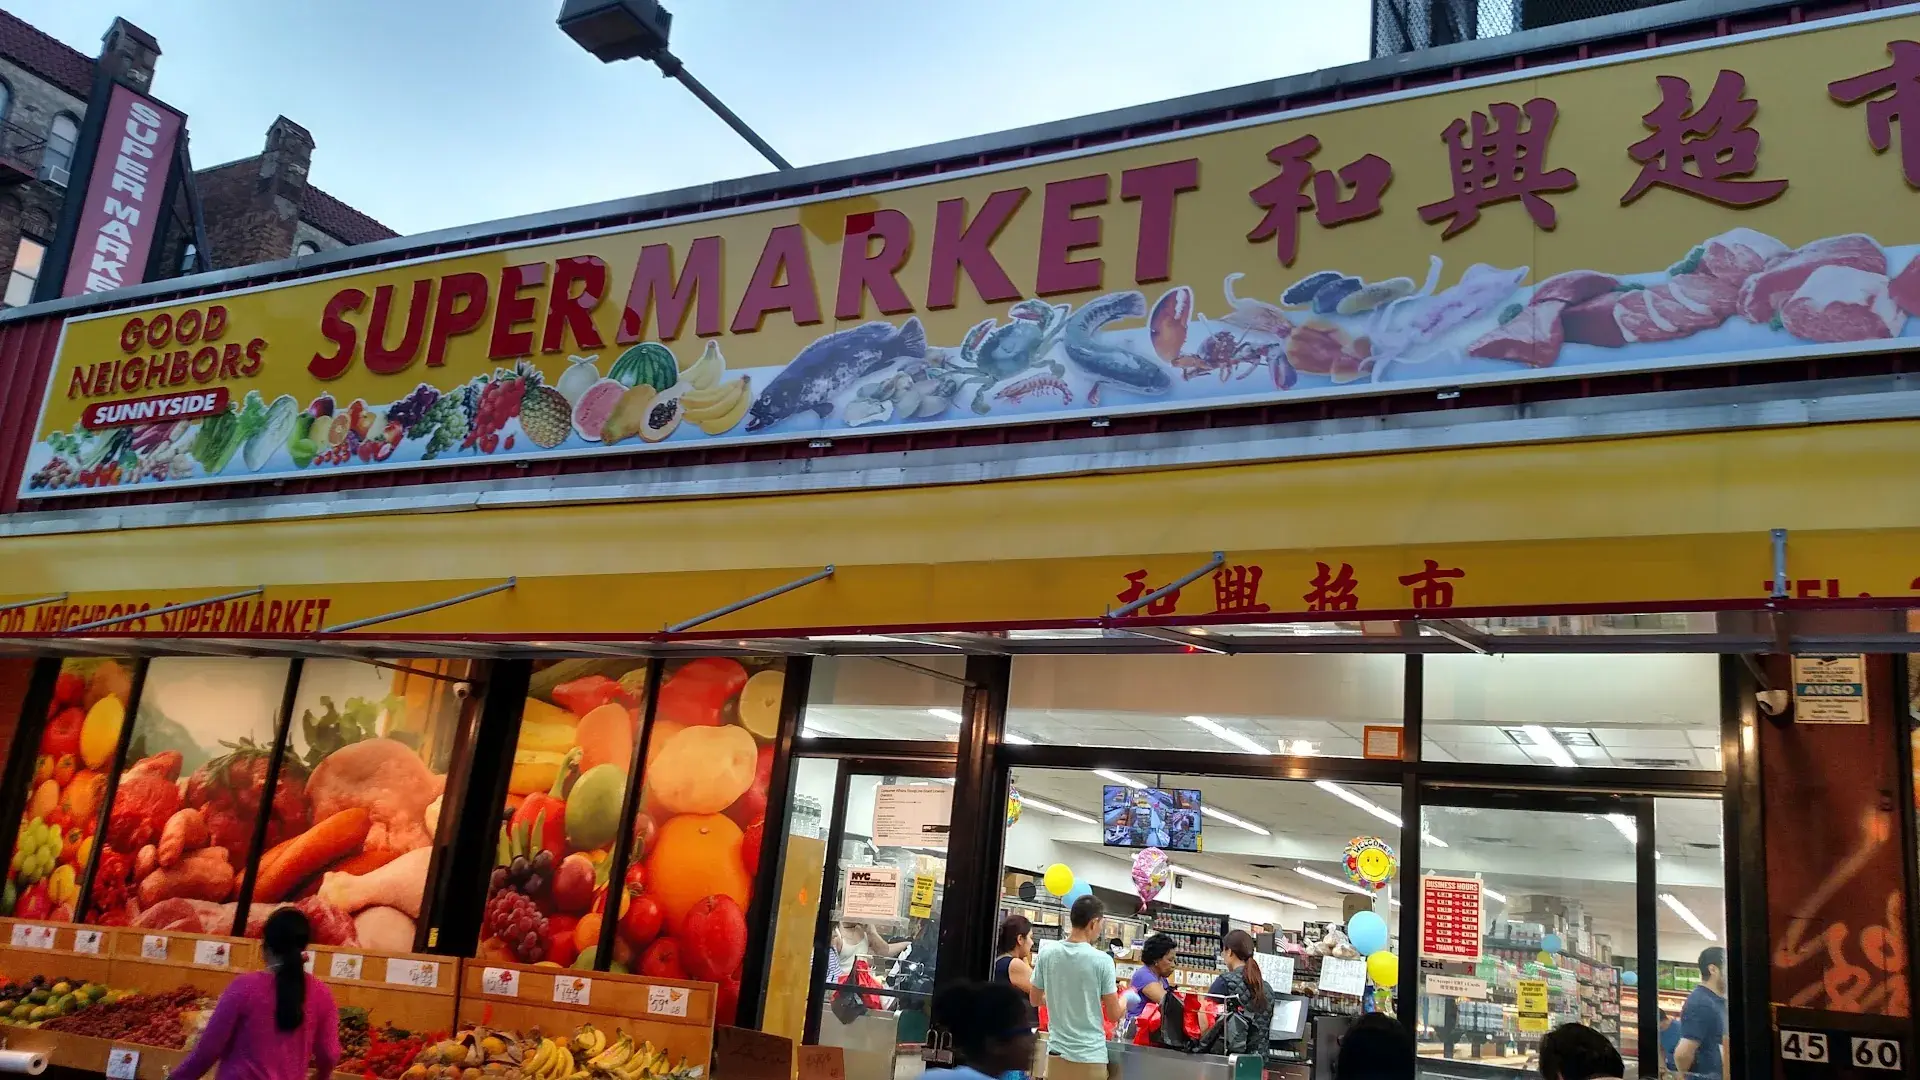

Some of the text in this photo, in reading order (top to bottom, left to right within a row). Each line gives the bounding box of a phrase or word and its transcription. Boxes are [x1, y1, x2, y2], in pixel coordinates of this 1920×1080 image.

[83, 102, 161, 295] SUPER MARKE
[307, 158, 1200, 381] SUPERMARKET
[120, 305, 228, 353] GOOD
[67, 338, 267, 399] NEIGHBORS
[93, 393, 217, 425] SUNNYSIDE
[1804, 685, 1855, 695] AVISO
[852, 872, 870, 880] NYC
[1426, 881, 1478, 891] BUSINESS HOURS
[1436, 944, 1453, 952] THANK
[1421, 960, 1443, 969] Exit
[1784, 1033, 1898, 1067] 45 60
